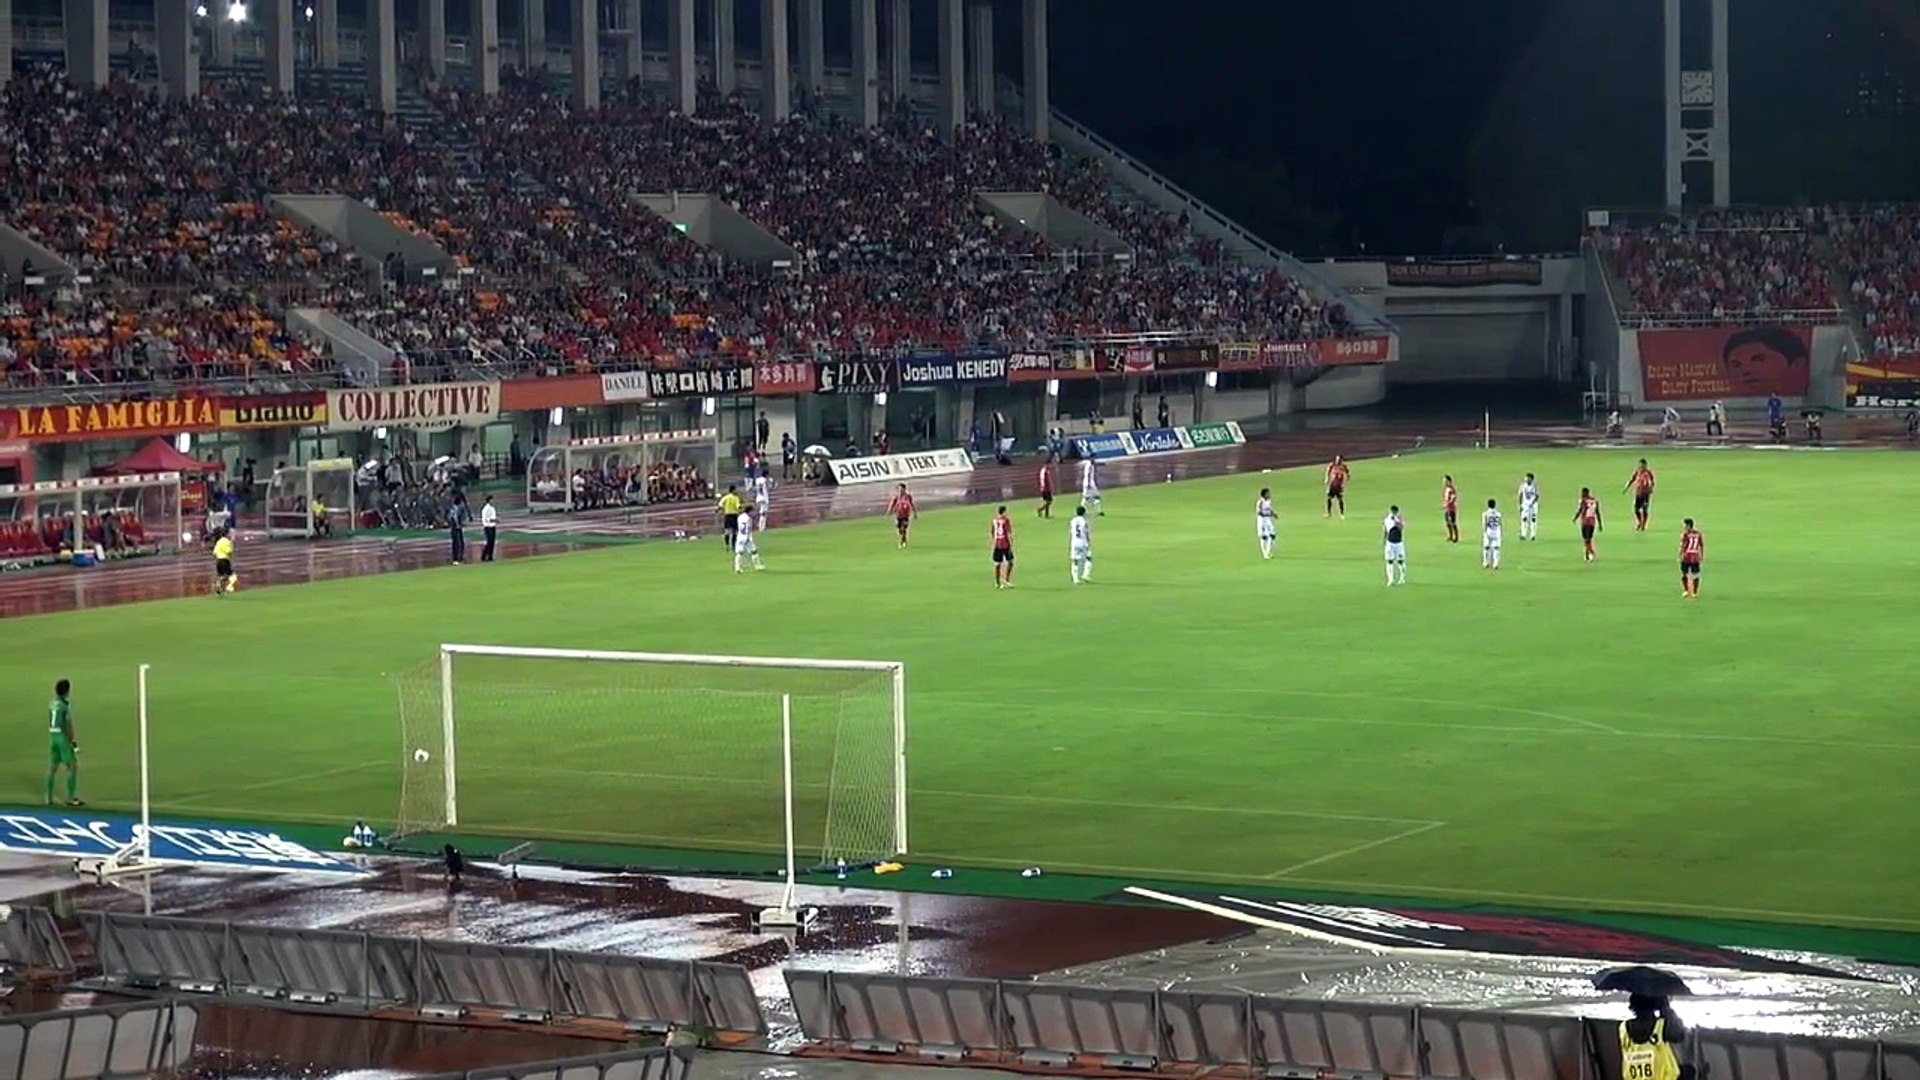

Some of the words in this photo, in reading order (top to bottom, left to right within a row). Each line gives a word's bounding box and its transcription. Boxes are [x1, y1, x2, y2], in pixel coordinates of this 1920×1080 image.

[837, 362, 891, 386] PIXY
[903, 363, 954, 382] Joshua
[956, 358, 1007, 380] KENEDY
[18, 408, 55, 434] LA
[66, 398, 215, 430] FAMIGLIA
[339, 386, 491, 422] COLLECTIVE
[839, 460, 891, 480] AISIN
[1629, 1063, 1653, 1080] 016
